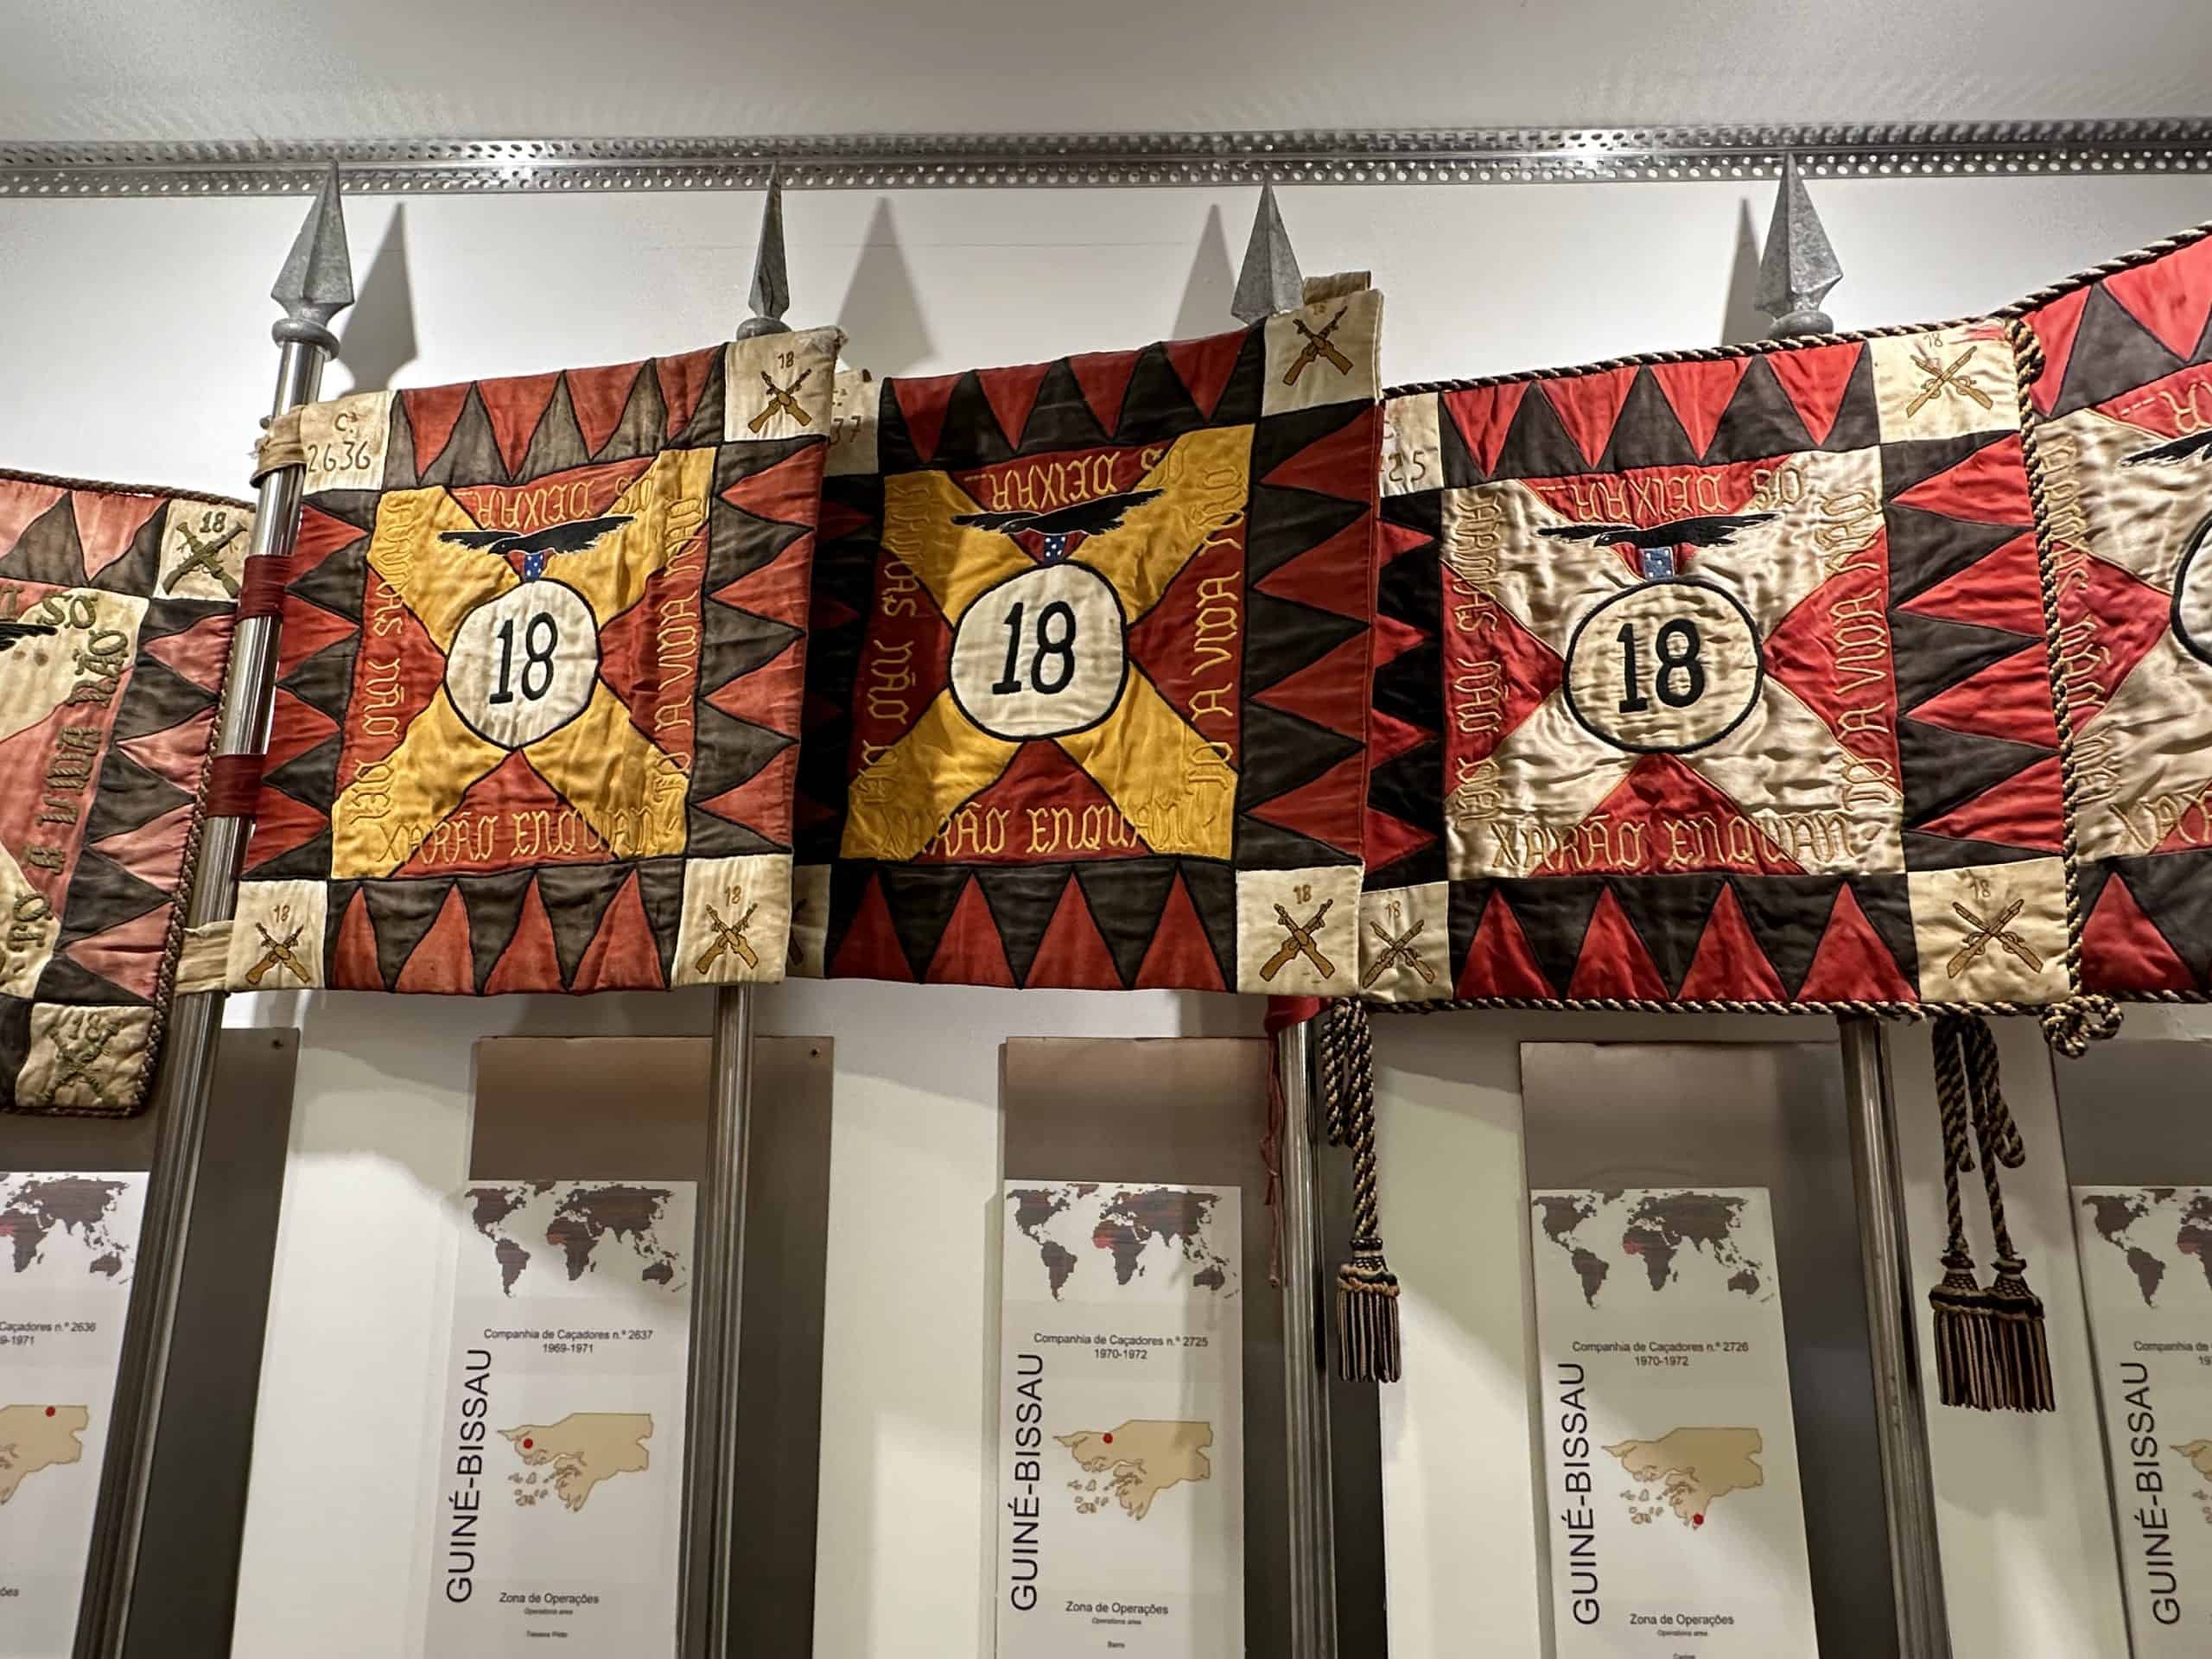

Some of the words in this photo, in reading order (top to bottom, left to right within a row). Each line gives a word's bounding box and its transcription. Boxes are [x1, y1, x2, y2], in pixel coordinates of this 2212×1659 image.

[1923, 334, 1943, 348] 18
[778, 351, 795, 369] 18
[830, 416, 861, 446] 37
[308, 440, 371, 472] 2636
[200, 512, 226, 534] 18
[992, 601, 1076, 696] 18
[489, 612, 558, 704] 18
[1616, 619, 1706, 714] 18
[723, 885, 741, 906] 18
[1294, 884, 1313, 905] 18
[273, 905, 290, 923] 18
[1385, 900, 1402, 919] 18
[71, 1322, 97, 1332] 2636
[484, 1329, 539, 1341] Companhia
[542, 1329, 554, 1339] de
[557, 1329, 609, 1341] Caçadores
[628, 1330, 653, 1339] 2637
[0, 1335, 35, 1346] 9-1971
[543, 1343, 594, 1353] 1969-1971
[1033, 1332, 1091, 1344] Companhia
[1094, 1334, 1107, 1344] de
[1109, 1334, 1164, 1347] Caçadores
[1183, 1337, 1209, 1347] 2725
[1572, 1341, 1630, 1353] Companhia
[1633, 1341, 1646, 1351] de
[1649, 1341, 1704, 1354] Caçadores
[1723, 1342, 1749, 1351] 2726
[2133, 1340, 2193, 1352] Companhia
[1094, 1349, 1147, 1359] 1970-1972
[1635, 1356, 1689, 1367] 1970-1972
[446, 1349, 492, 1603] GUINÉ-BISSAU
[1007, 1353, 1044, 1611] GUINÉ-BISSAU
[1558, 1363, 1600, 1625] GUINÉ-BISSAU
[2120, 1361, 2181, 1625] GUINÉ-BISSAU
[499, 1592, 525, 1603] Zona
[529, 1593, 541, 1603] de
[544, 1592, 599, 1606] Operações
[1065, 1600, 1092, 1611] Zona
[1095, 1602, 1109, 1612] de
[1111, 1602, 1168, 1616] Operações
[1630, 1613, 1657, 1624] Zona
[1660, 1614, 1673, 1624] de
[1676, 1613, 1734, 1628] Operações
